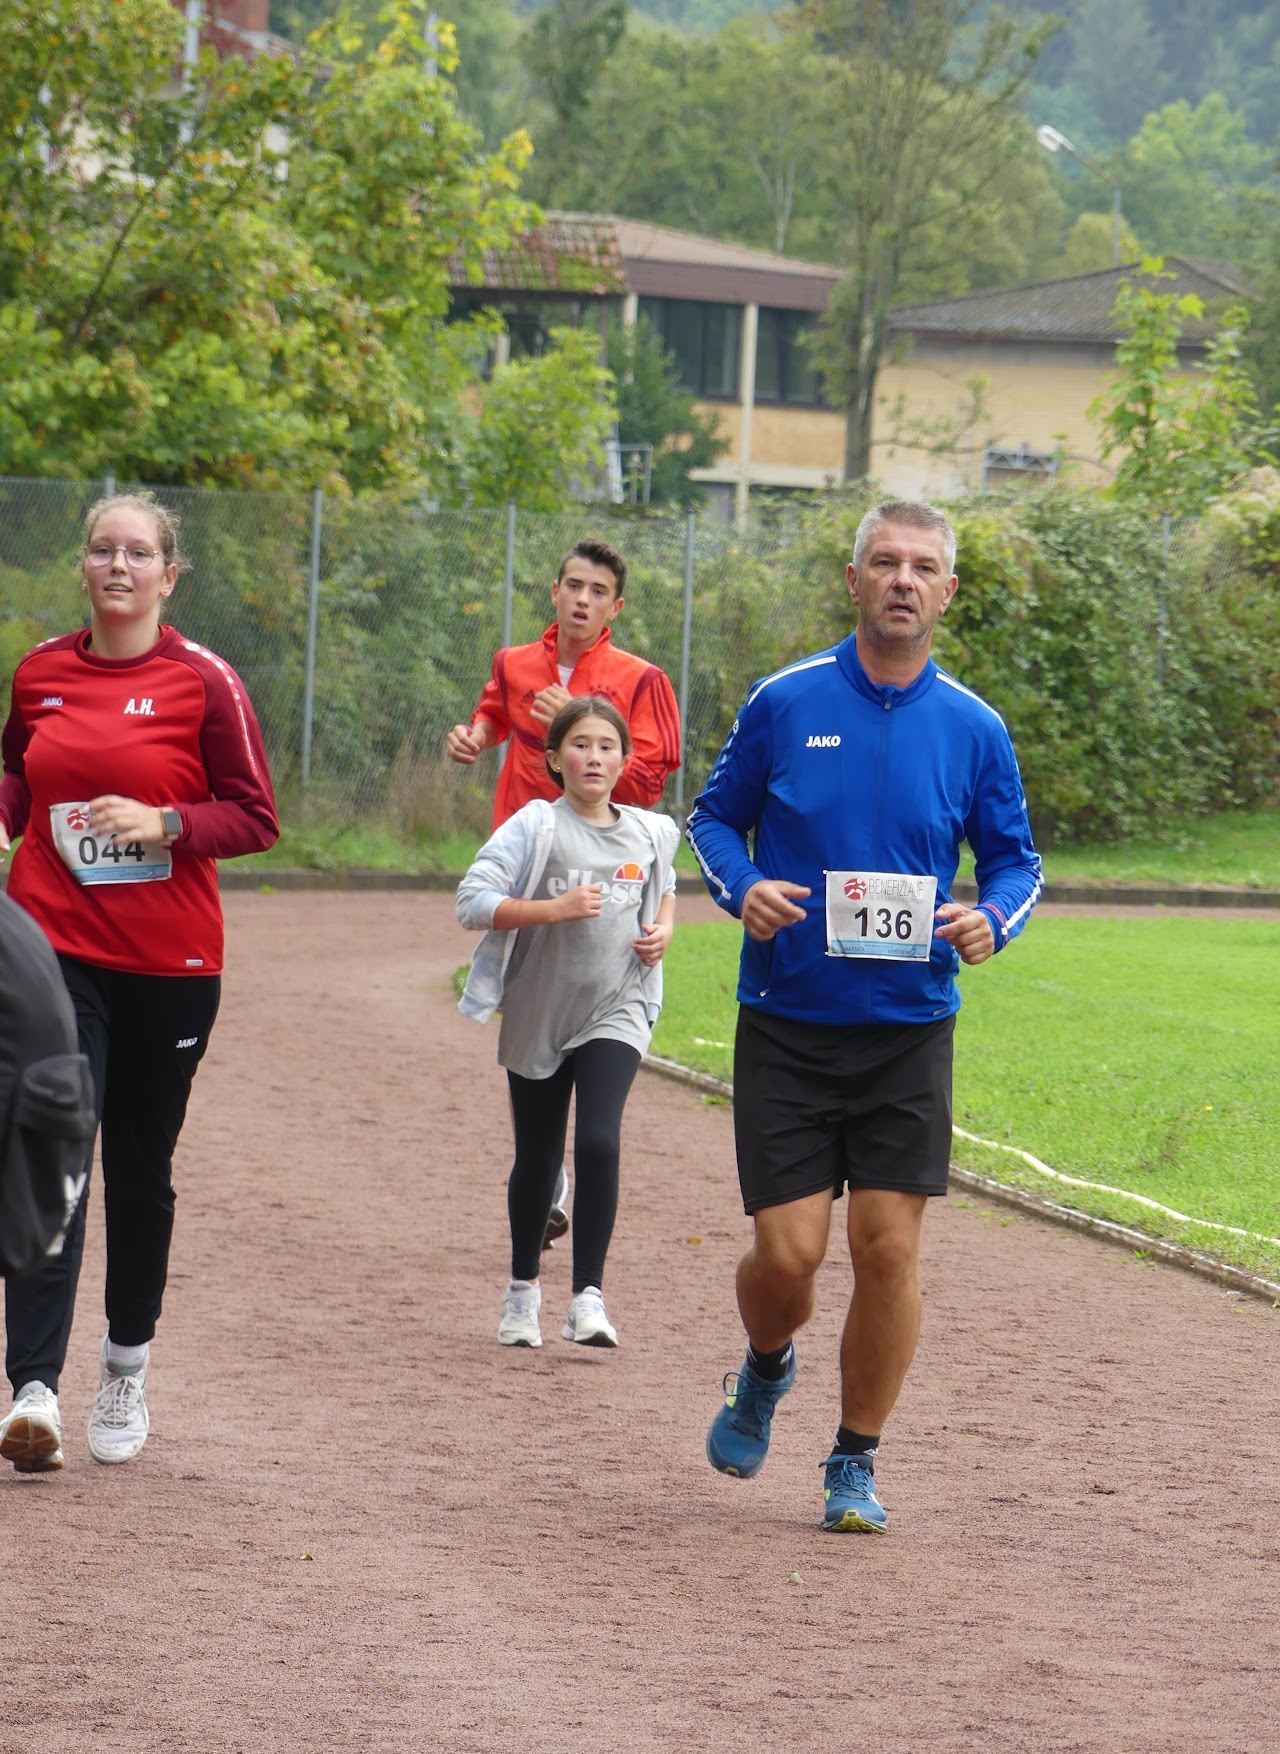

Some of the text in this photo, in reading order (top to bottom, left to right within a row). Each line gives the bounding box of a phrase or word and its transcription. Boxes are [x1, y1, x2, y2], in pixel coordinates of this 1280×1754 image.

[123, 698, 155, 715] A.H.
[806, 735, 841, 747] JAKO
[79, 833, 145, 865] 044
[547, 868, 643, 905] elless
[854, 907, 913, 940] 136
[176, 1036, 198, 1048] JAKO
